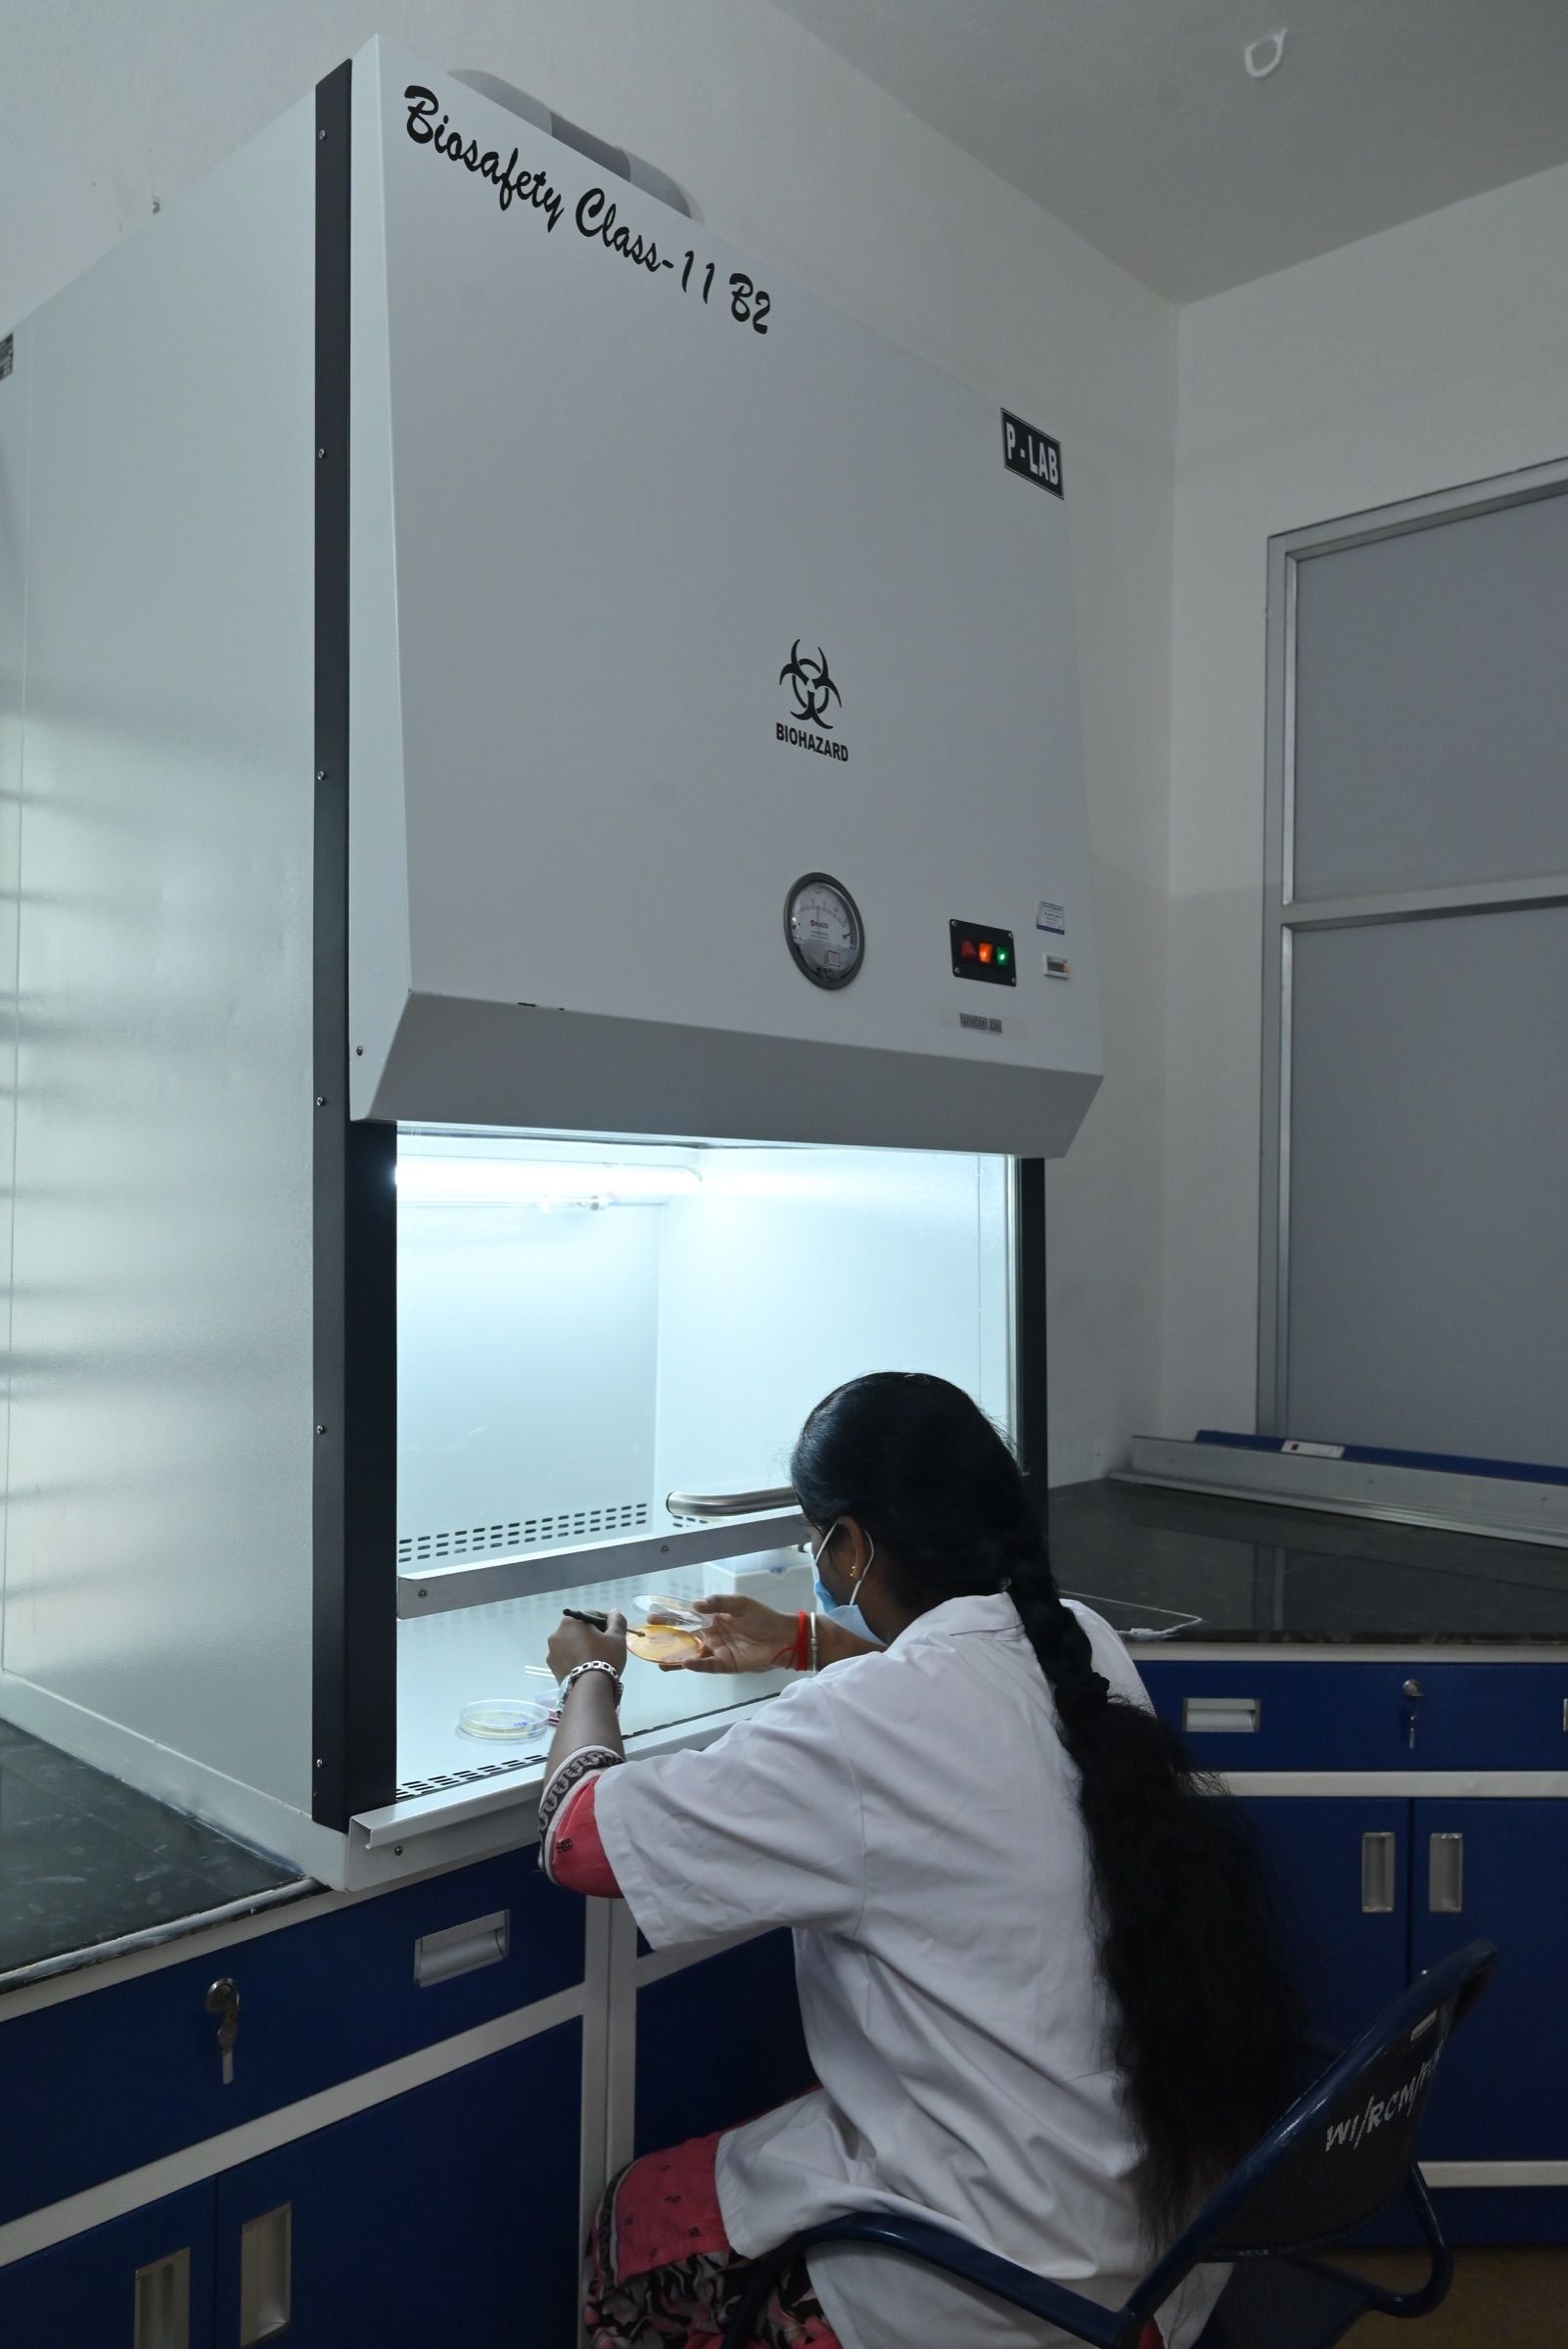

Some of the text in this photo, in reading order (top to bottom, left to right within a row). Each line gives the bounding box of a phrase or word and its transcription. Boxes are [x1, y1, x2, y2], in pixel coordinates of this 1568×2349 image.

[403, 84, 565, 233] Biosafety
[728, 271, 771, 335] B2
[775, 721, 849, 762] BIOHAZARD
